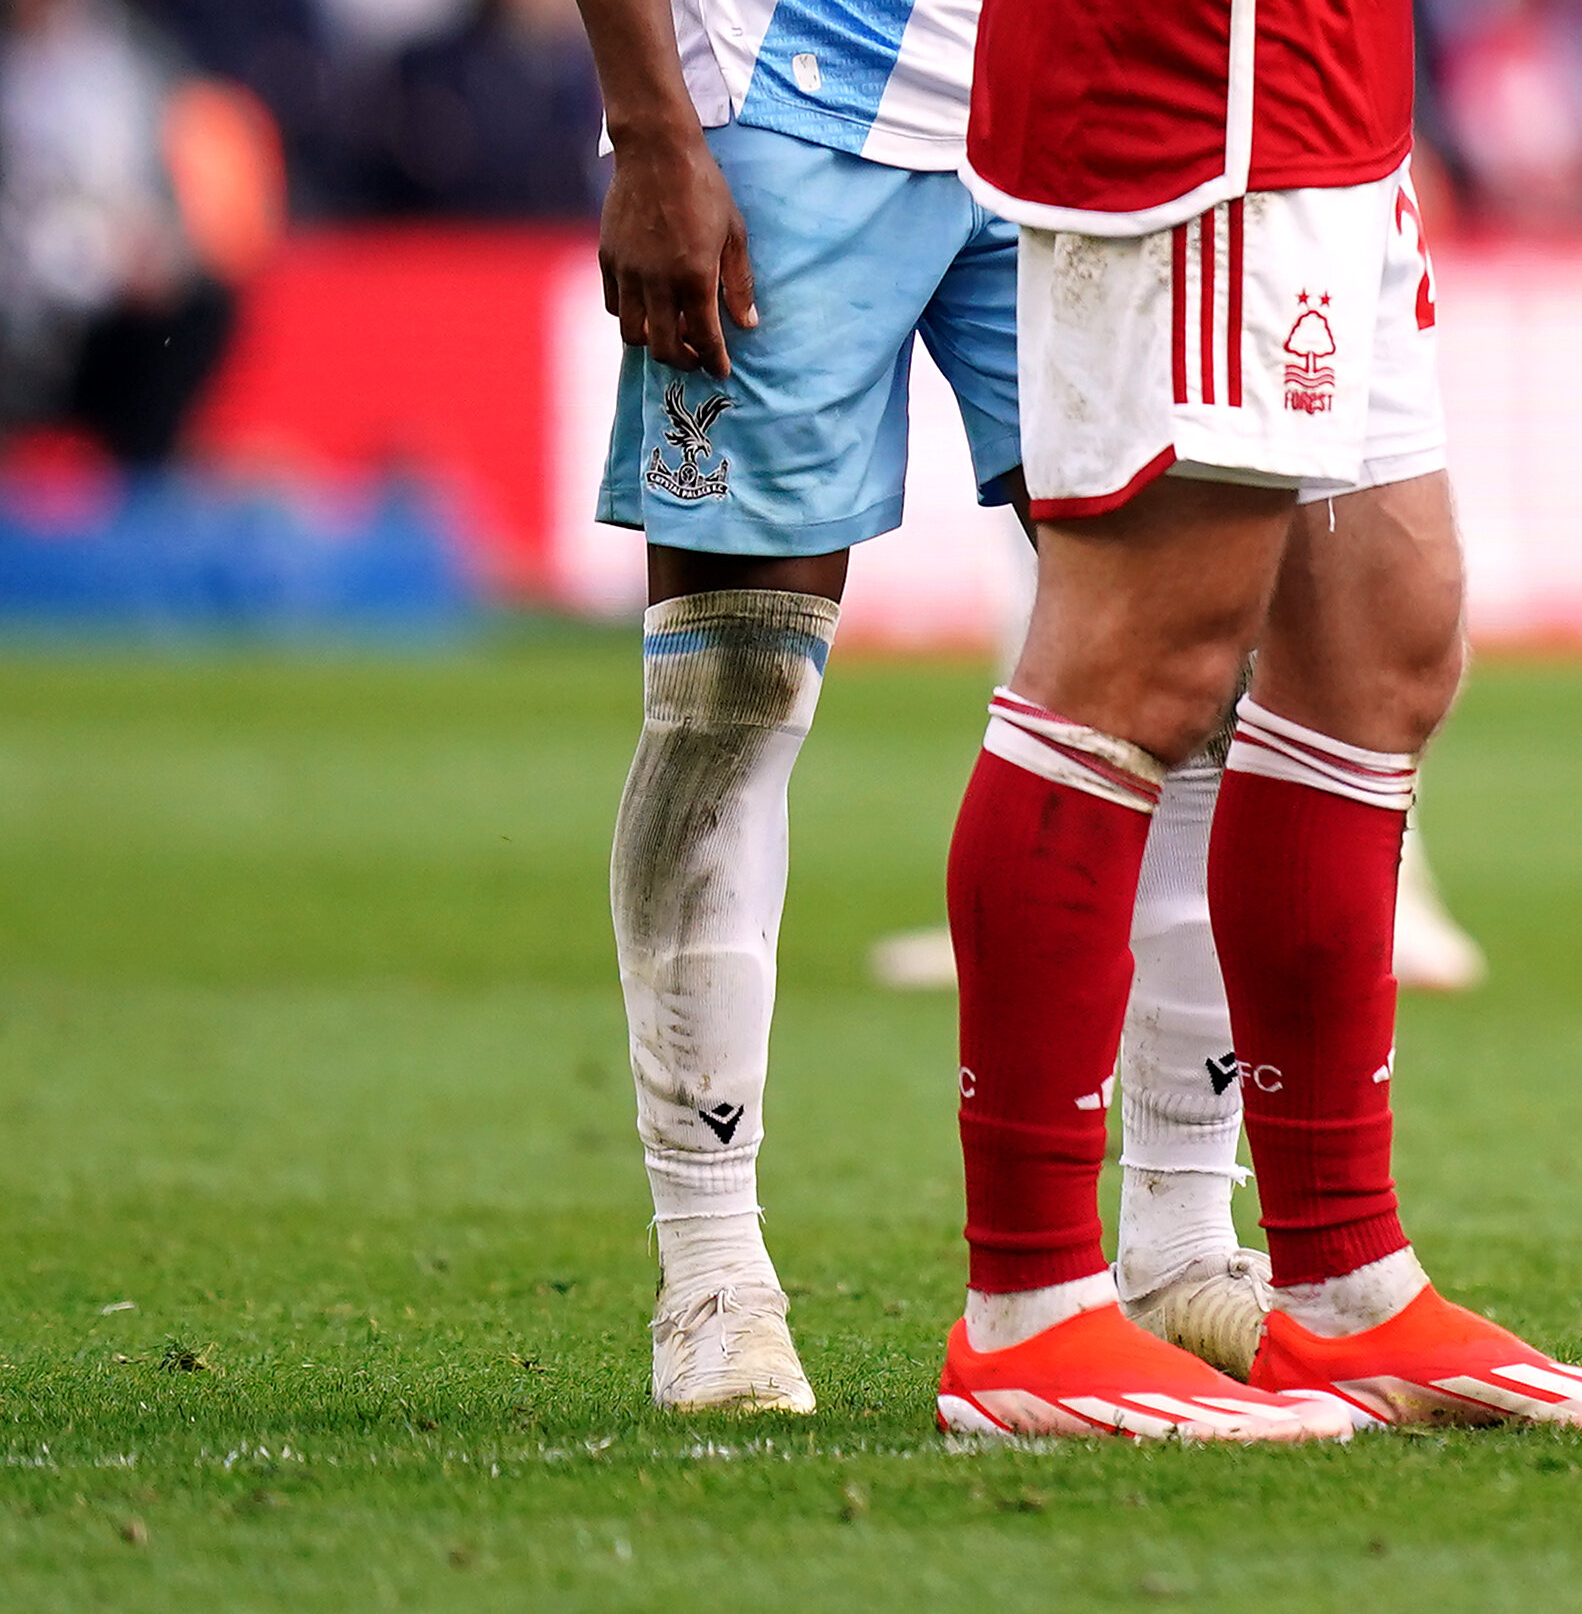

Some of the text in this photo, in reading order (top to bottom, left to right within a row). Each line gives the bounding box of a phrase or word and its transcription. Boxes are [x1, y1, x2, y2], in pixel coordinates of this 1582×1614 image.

[1284, 390, 1332, 415] FOREST
[649, 472, 681, 497] CRYSTAL
[681, 485, 711, 499] PALACE
